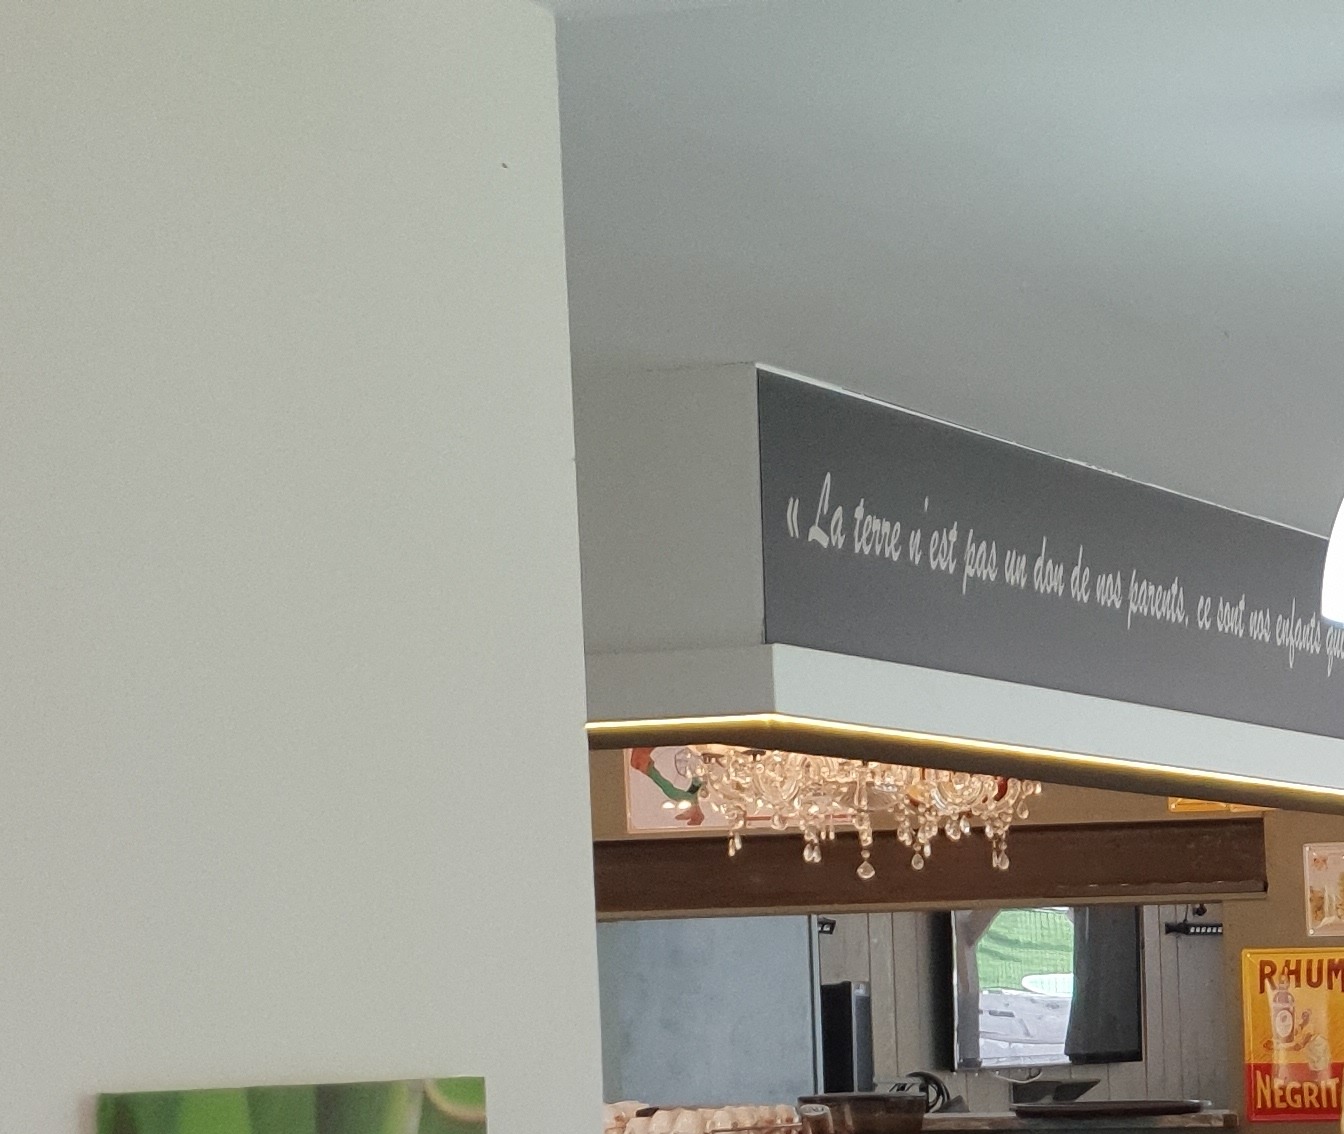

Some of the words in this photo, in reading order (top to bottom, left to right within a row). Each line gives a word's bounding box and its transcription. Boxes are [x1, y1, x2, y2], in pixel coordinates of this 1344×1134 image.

[808, 471, 846, 548] La
[854, 498, 902, 561] terre
[909, 495, 957, 574] n'est
[962, 528, 998, 595] pas
[1004, 550, 1027, 589] un
[1033, 536, 1065, 597] don
[1071, 544, 1091, 603] de
[1096, 571, 1122, 609] nos
[1197, 595, 1212, 631] ce
[1217, 593, 1245, 638] sont
[1250, 608, 1272, 642] nos
[1276, 597, 1321, 669] enfants
